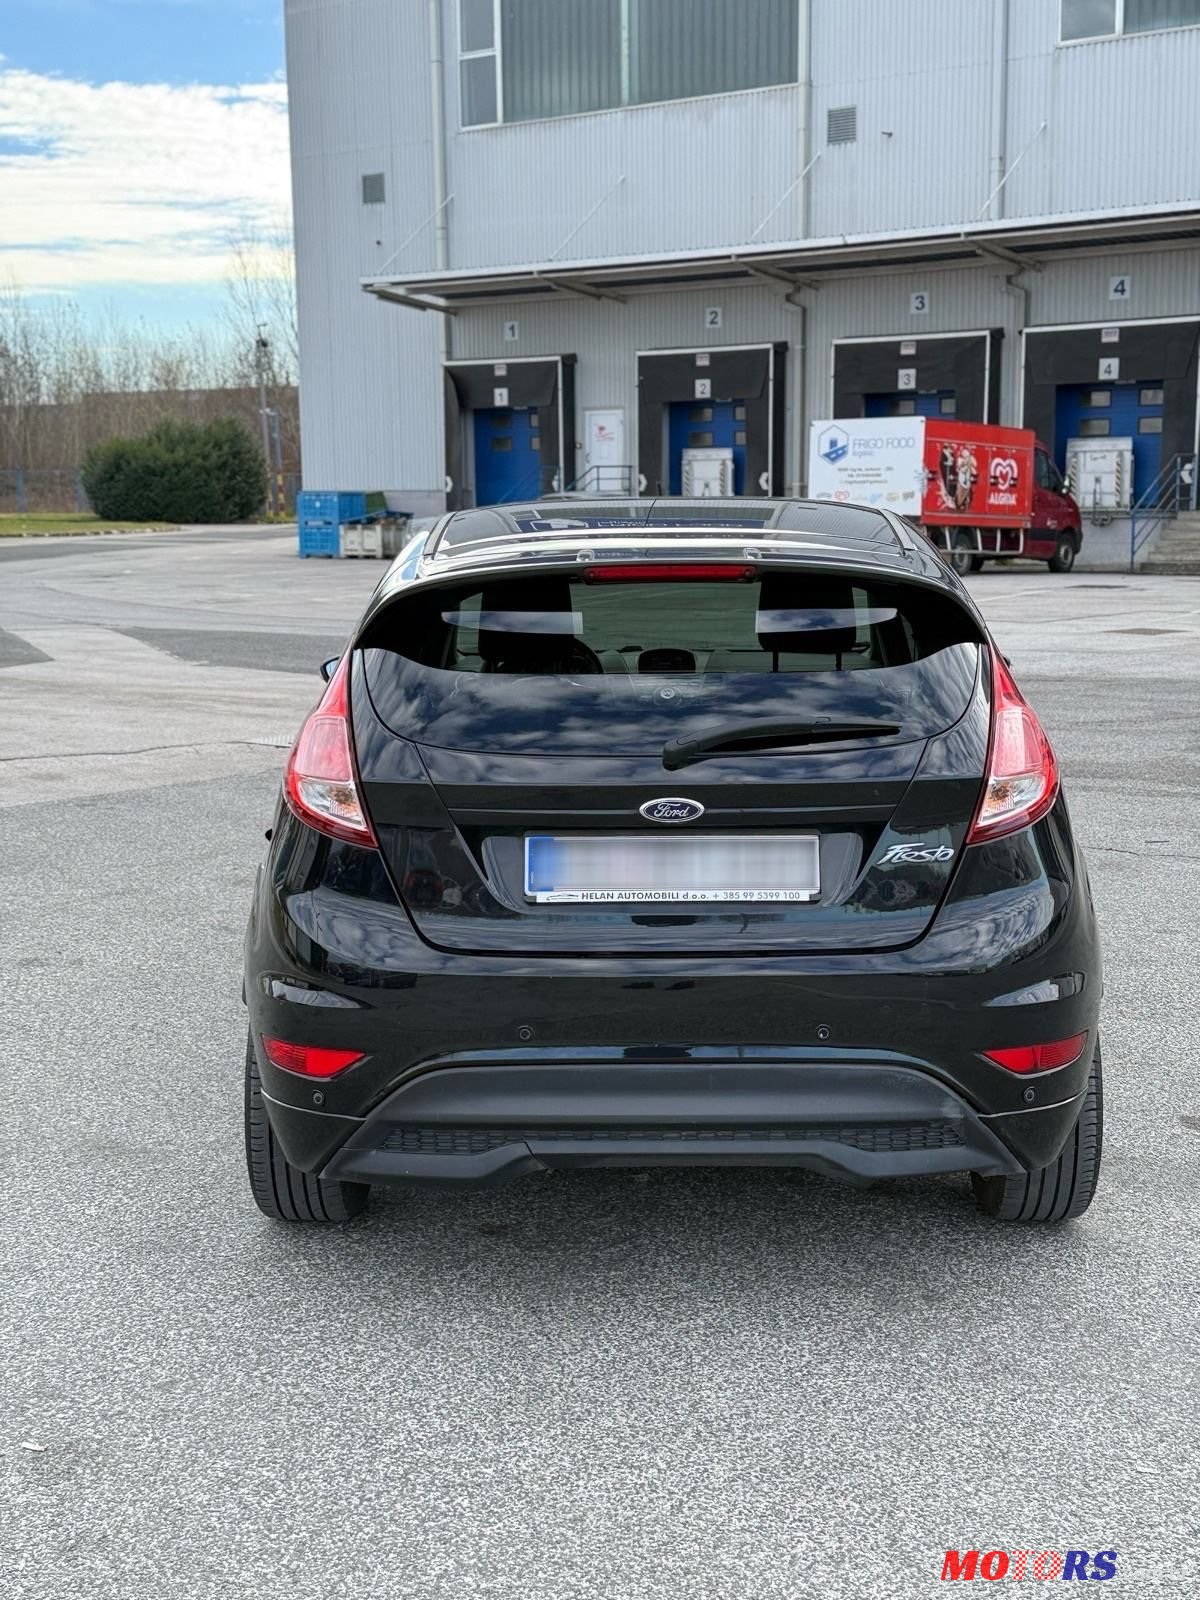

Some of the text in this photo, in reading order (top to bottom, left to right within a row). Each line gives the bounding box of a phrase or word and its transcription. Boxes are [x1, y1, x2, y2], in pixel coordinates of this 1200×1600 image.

[1113, 279, 1127, 296] 4
[914, 295, 926, 311] 3
[709, 310, 719, 325] 2
[508, 323, 516, 338] 1
[1103, 362, 1112, 376] 4
[903, 373, 912, 386] 3
[699, 383, 708, 395] 2
[852, 437, 915, 449] FRIGO FOOD
[989, 492, 1017, 506] ALGIDA
[654, 802, 690, 817] Ford
[876, 842, 955, 865] Fiesta
[581, 891, 614, 900] HELAN
[617, 891, 679, 900] AUTOMOBILI
[682, 891, 709, 900] d.o.o.
[723, 891, 740, 900] 385
[742, 891, 755, 900] 99
[757, 891, 780, 900] 5399
[783, 891, 801, 900] 100
